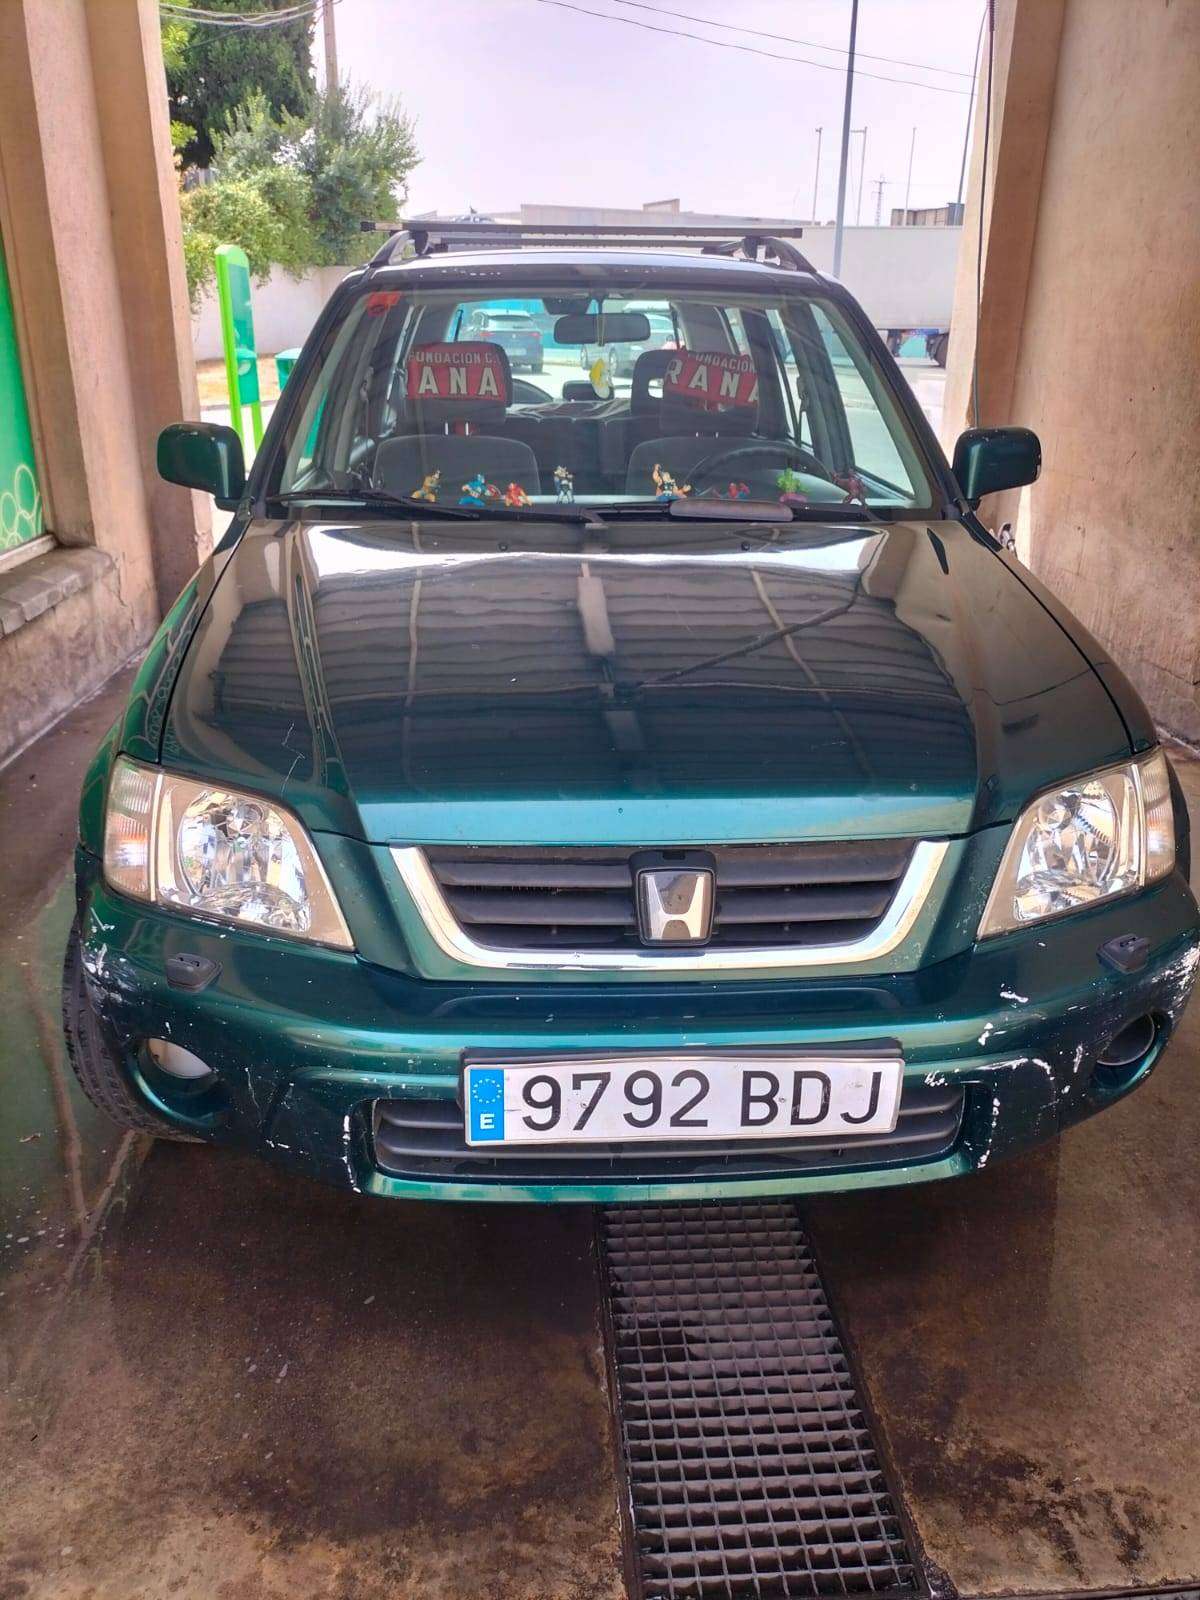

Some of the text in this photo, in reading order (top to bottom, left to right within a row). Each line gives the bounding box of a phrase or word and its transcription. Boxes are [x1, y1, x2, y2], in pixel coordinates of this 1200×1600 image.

[404, 366, 498, 395] ANA
[522, 1069, 882, 1131] 9792 BDJ
[480, 1113, 495, 1130] E
